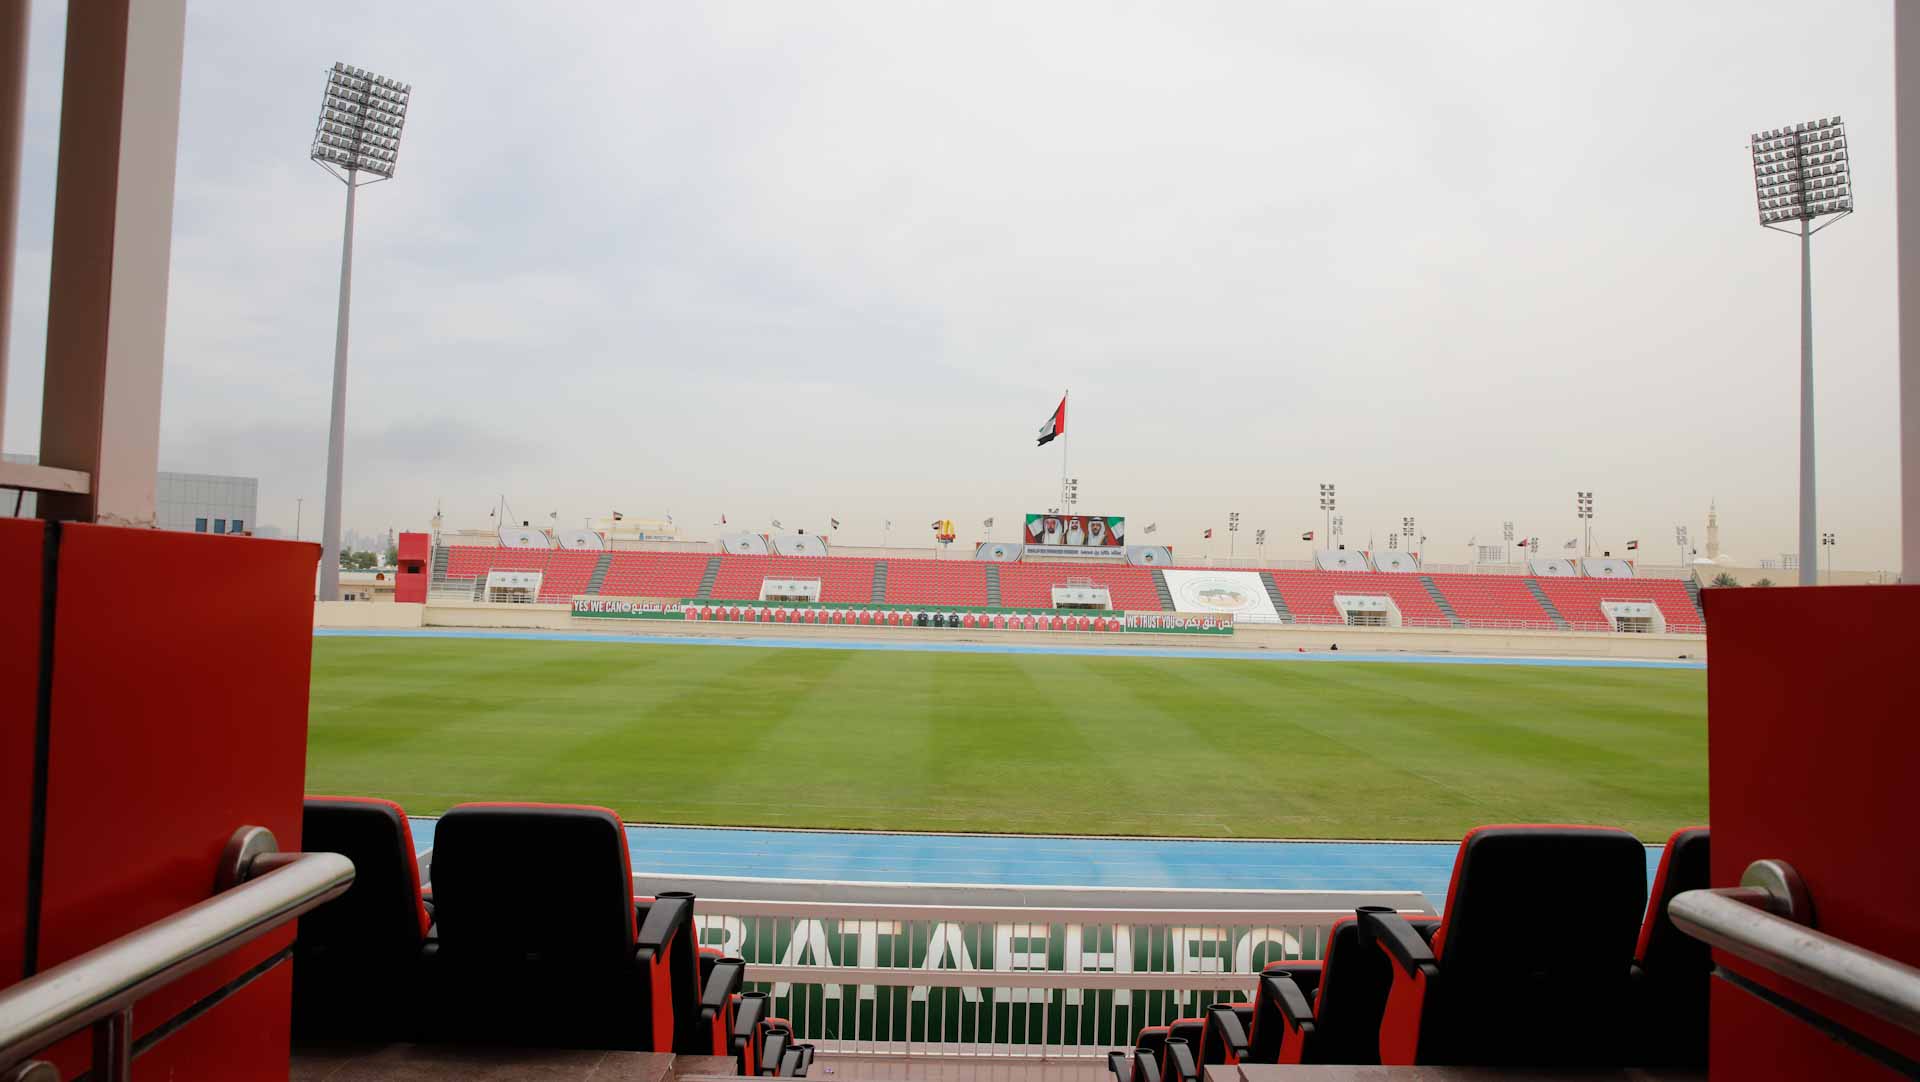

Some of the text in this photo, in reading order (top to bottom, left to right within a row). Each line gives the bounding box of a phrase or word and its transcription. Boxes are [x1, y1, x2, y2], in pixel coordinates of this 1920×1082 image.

[574, 601, 622, 612] YES WE CAN
[664, 602, 681, 614] نعم
[1126, 615, 1175, 628] WE TRUST YOU
[1184, 616, 1200, 630] بكم
[1217, 616, 1233, 630] نحن
[1172, 927, 1303, 1006] FC
